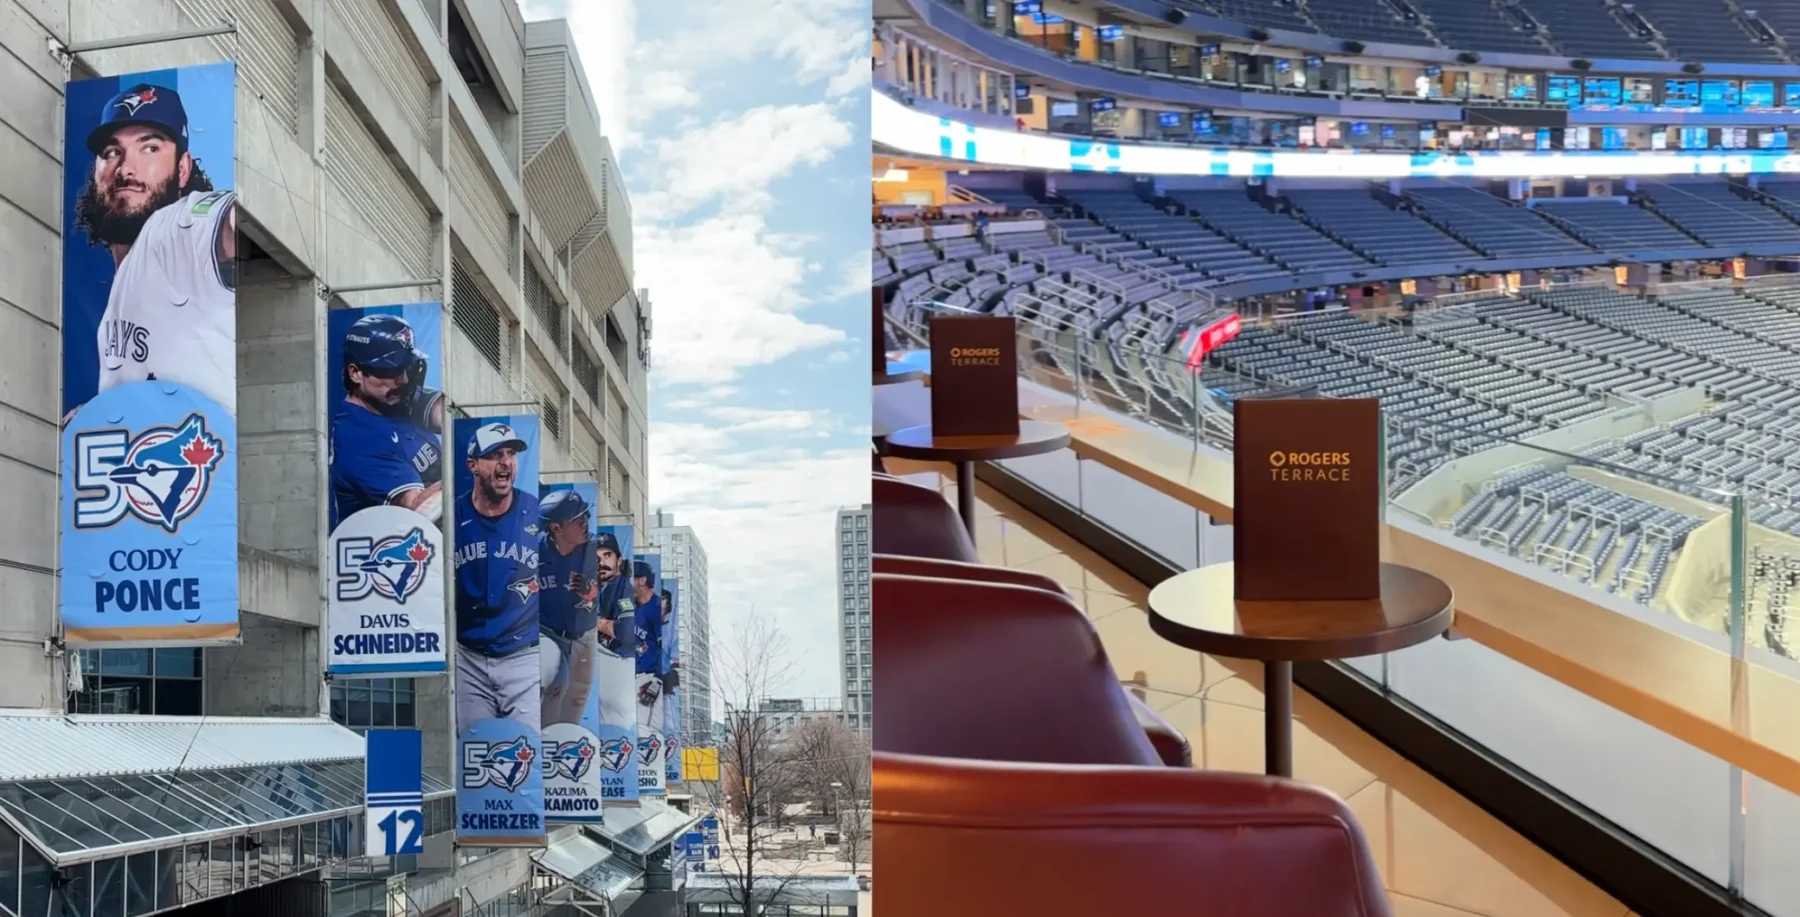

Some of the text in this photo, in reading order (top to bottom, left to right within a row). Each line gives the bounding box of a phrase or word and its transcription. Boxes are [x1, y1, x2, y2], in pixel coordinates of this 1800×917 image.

[105, 319, 150, 362] JAYS
[962, 348, 1000, 356] ROGERS
[950, 358, 1000, 366] TERRACE
[1289, 452, 1351, 465] ROGERS
[1270, 468, 1350, 481] TERRACE
[109, 548, 183, 572] CODY
[455, 541, 539, 570] BLUE JAYS
[95, 578, 201, 613] PONCE
[360, 614, 410, 629] DAVIS
[334, 632, 440, 655] SCHNEIDER
[544, 787, 588, 796] KAZUMA
[601, 787, 625, 797] EASE
[484, 800, 514, 811] MAX
[544, 799, 599, 812] KAMOTO
[461, 813, 540, 830] SCHERZER
[377, 809, 424, 856] 12
[707, 844, 720, 860] 10
